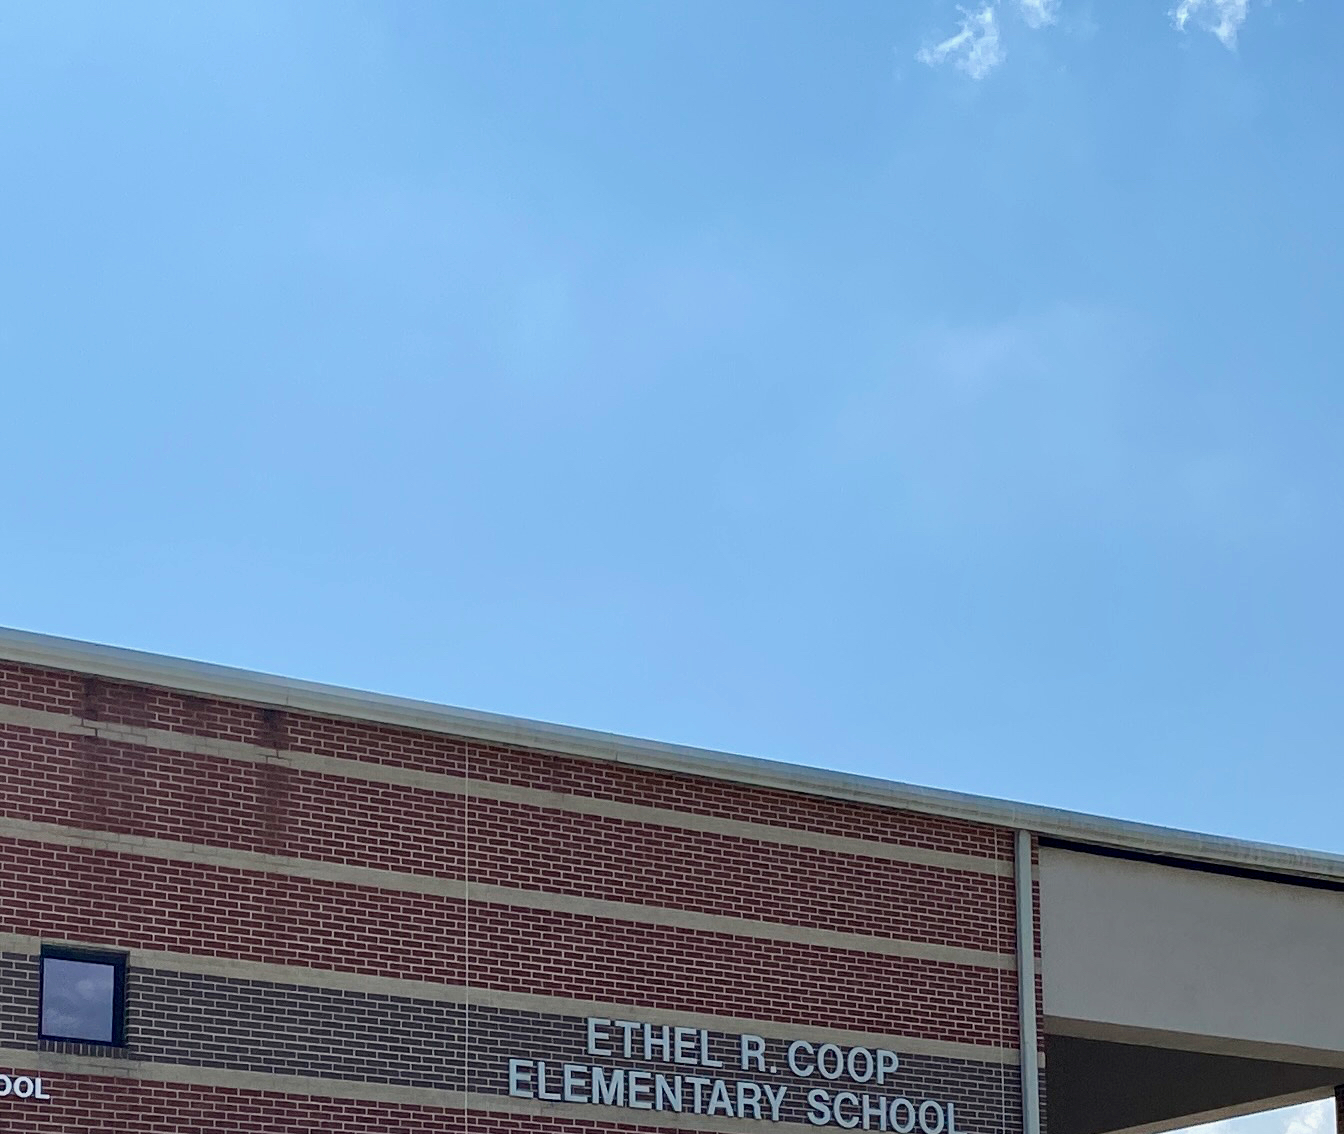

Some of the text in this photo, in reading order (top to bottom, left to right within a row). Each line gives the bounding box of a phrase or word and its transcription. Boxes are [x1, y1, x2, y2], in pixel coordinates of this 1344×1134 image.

[586, 1017, 899, 1085] ETHEL R. COOP
[508, 1058, 788, 1122] ELEMENTARY
